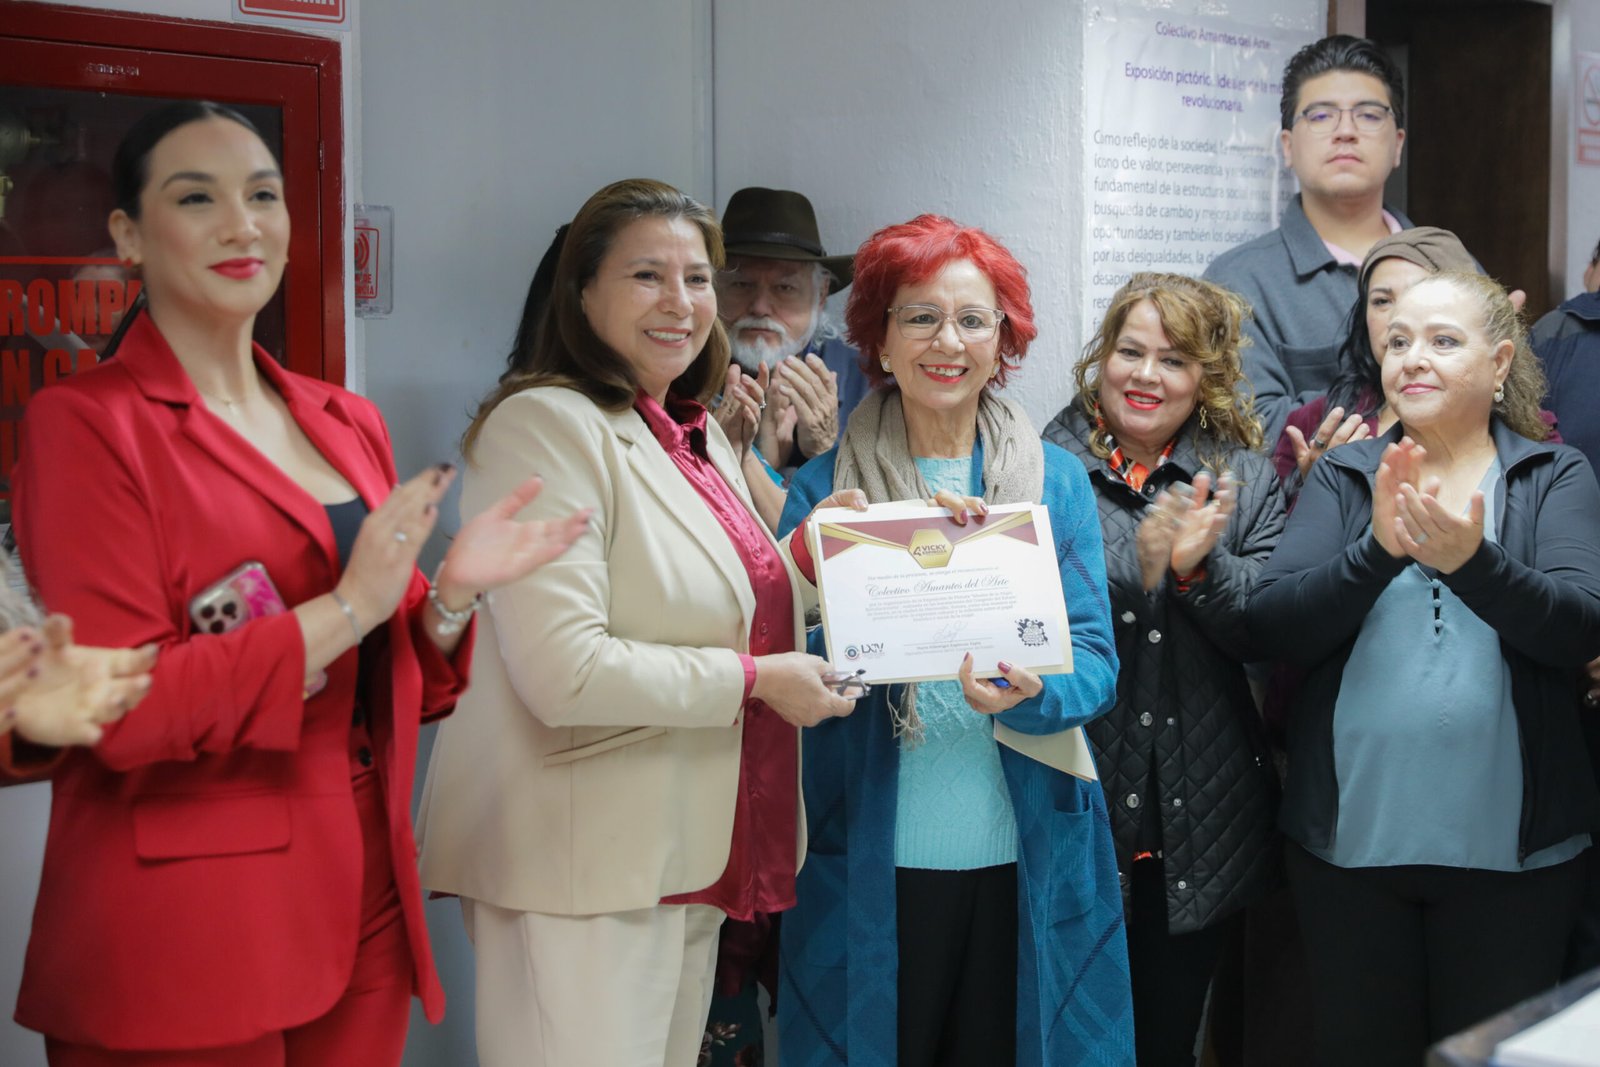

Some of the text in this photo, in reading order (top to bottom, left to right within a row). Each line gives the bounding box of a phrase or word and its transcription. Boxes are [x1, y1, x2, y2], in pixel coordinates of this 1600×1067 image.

[1155, 20, 1271, 49] Colectivo Amantes del Arte
[1125, 62, 1174, 82] Exposición
[1122, 132, 1157, 151] reflejo
[1158, 134, 1170, 150] de
[1170, 135, 1179, 150] la
[1121, 155, 1137, 170] de
[1138, 156, 1165, 173] valor,
[1093, 176, 1158, 195] fundamental
[1159, 180, 1172, 195] de
[1172, 181, 1181, 196] la
[1145, 203, 1158, 217] de
[1159, 204, 1194, 218] cambio
[1172, 227, 1212, 242] también
[1092, 250, 1110, 266] por
[1111, 248, 1126, 262] las
[1127, 248, 1194, 267] desigualdades,
[1195, 249, 1205, 264] la
[865, 575, 1010, 597] Colectivo Amantes del Arte
